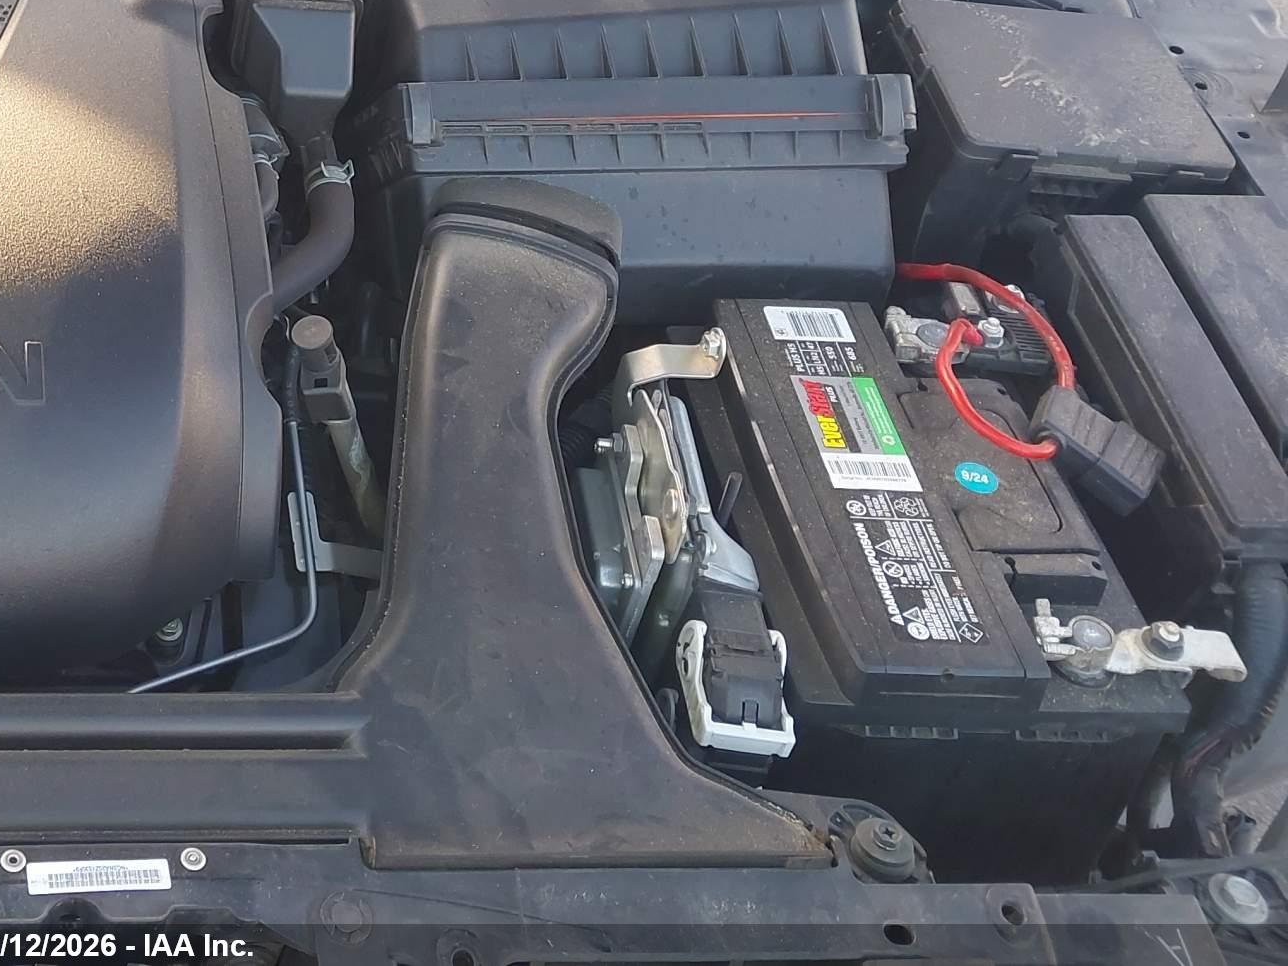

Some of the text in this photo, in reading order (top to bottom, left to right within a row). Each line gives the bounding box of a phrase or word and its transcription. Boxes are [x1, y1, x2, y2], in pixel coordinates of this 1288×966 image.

[802, 380, 847, 448] EverStart
[825, 386, 838, 403] PLUS
[960, 469, 989, 485] 9/24
[853, 522, 900, 614] DANGER/POISON
